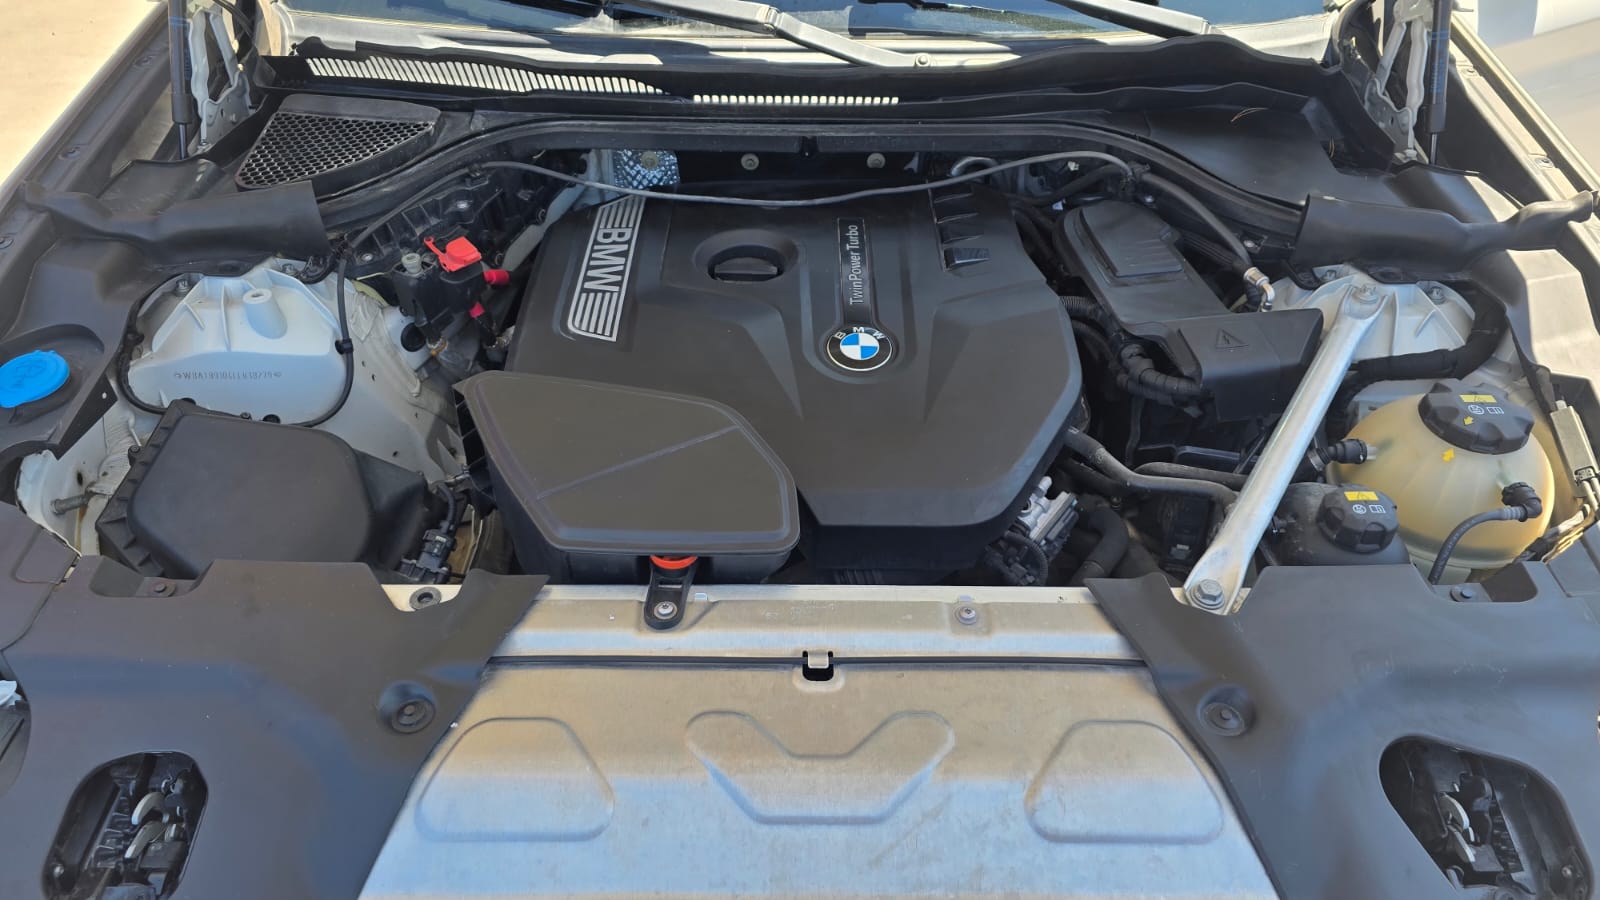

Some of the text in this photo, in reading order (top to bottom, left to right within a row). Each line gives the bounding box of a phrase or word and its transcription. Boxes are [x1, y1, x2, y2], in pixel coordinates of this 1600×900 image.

[583, 227, 633, 292] BMW
[845, 224, 864, 306] TwinPower Turbo
[833, 326, 887, 340] BMW
